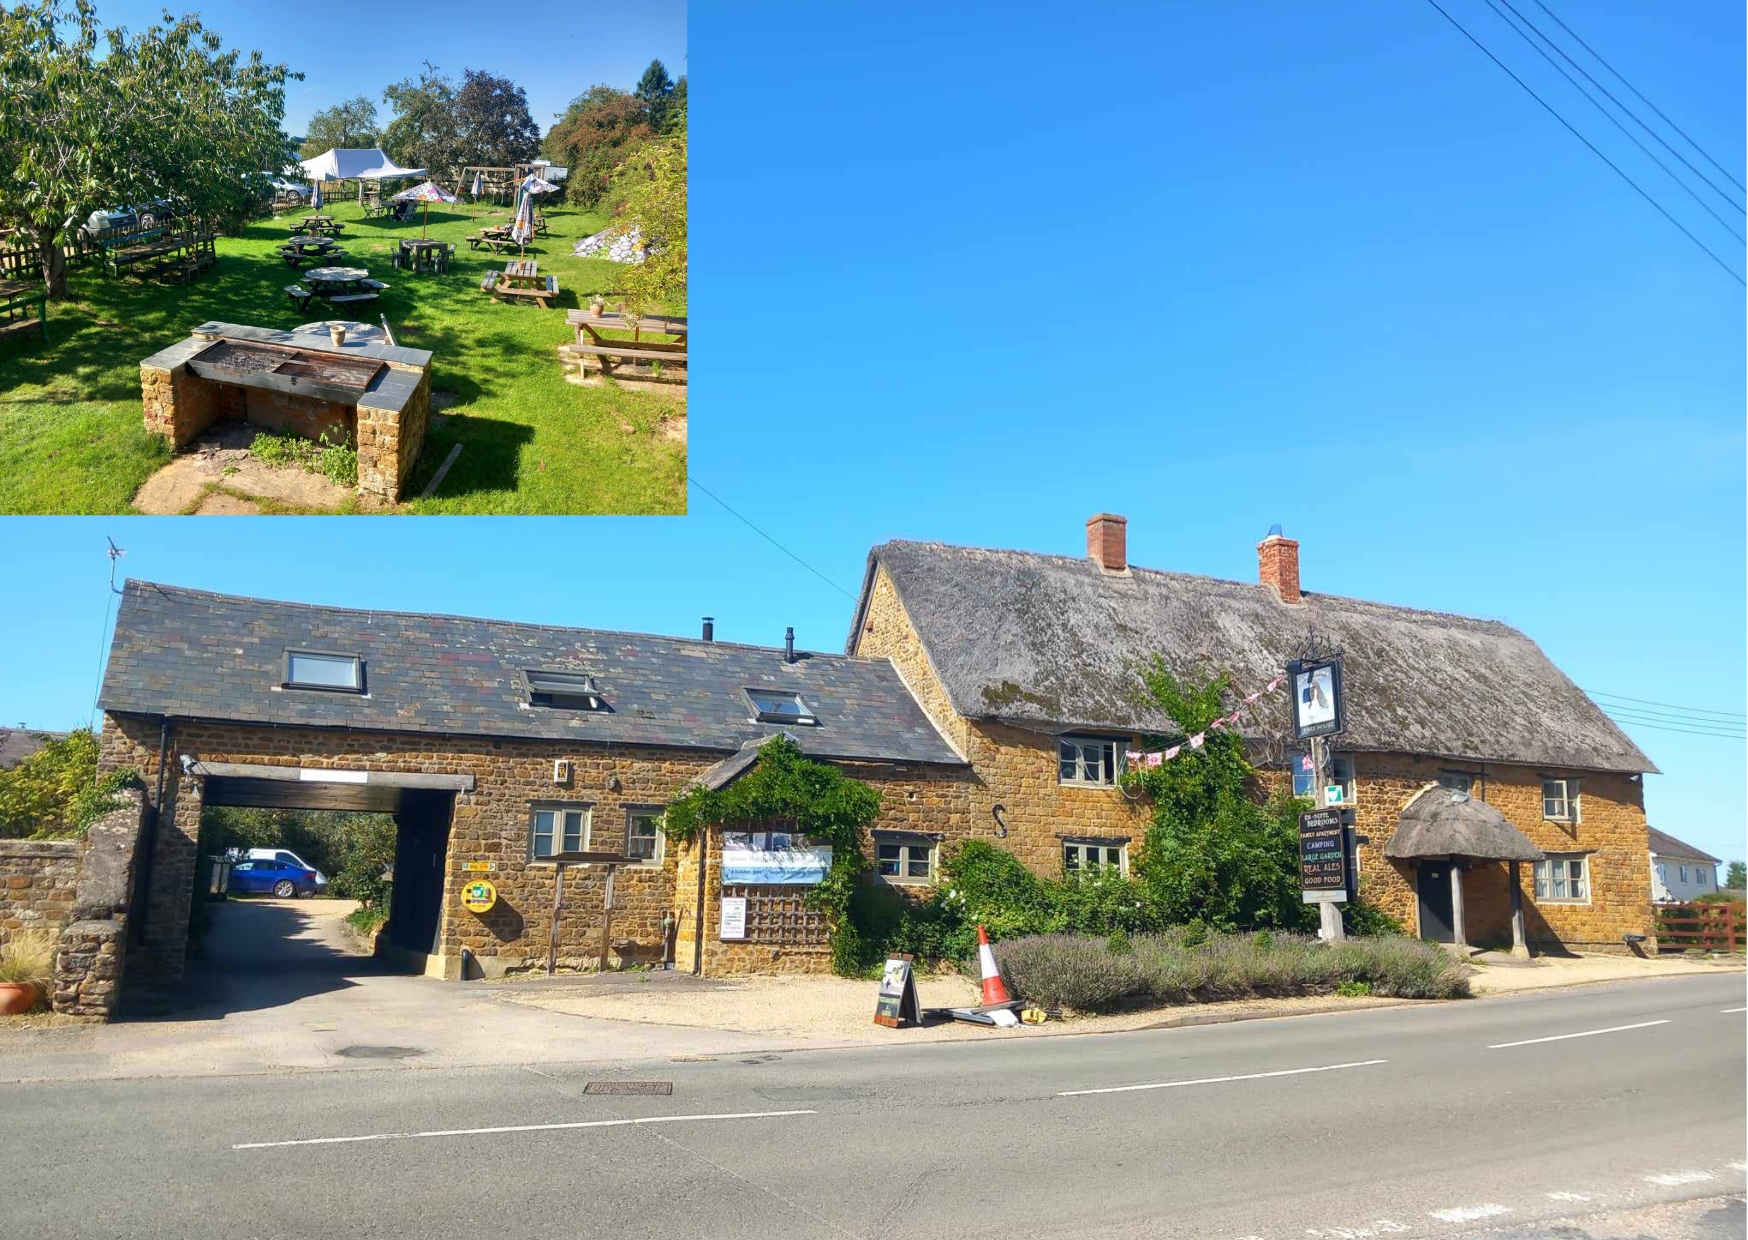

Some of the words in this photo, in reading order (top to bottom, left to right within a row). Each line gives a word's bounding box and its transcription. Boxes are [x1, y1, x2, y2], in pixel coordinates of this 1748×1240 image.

[1306, 818, 1338, 827] BEDROOMS
[1306, 840, 1335, 849] CAMPING
[1302, 854, 1319, 862] LARGE
[1320, 851, 1342, 860] GARDEN
[1303, 864, 1321, 875] REAL
[1323, 862, 1341, 871] ALES
[1304, 876, 1322, 885] GOOD
[1323, 875, 1341, 883] FOOD
